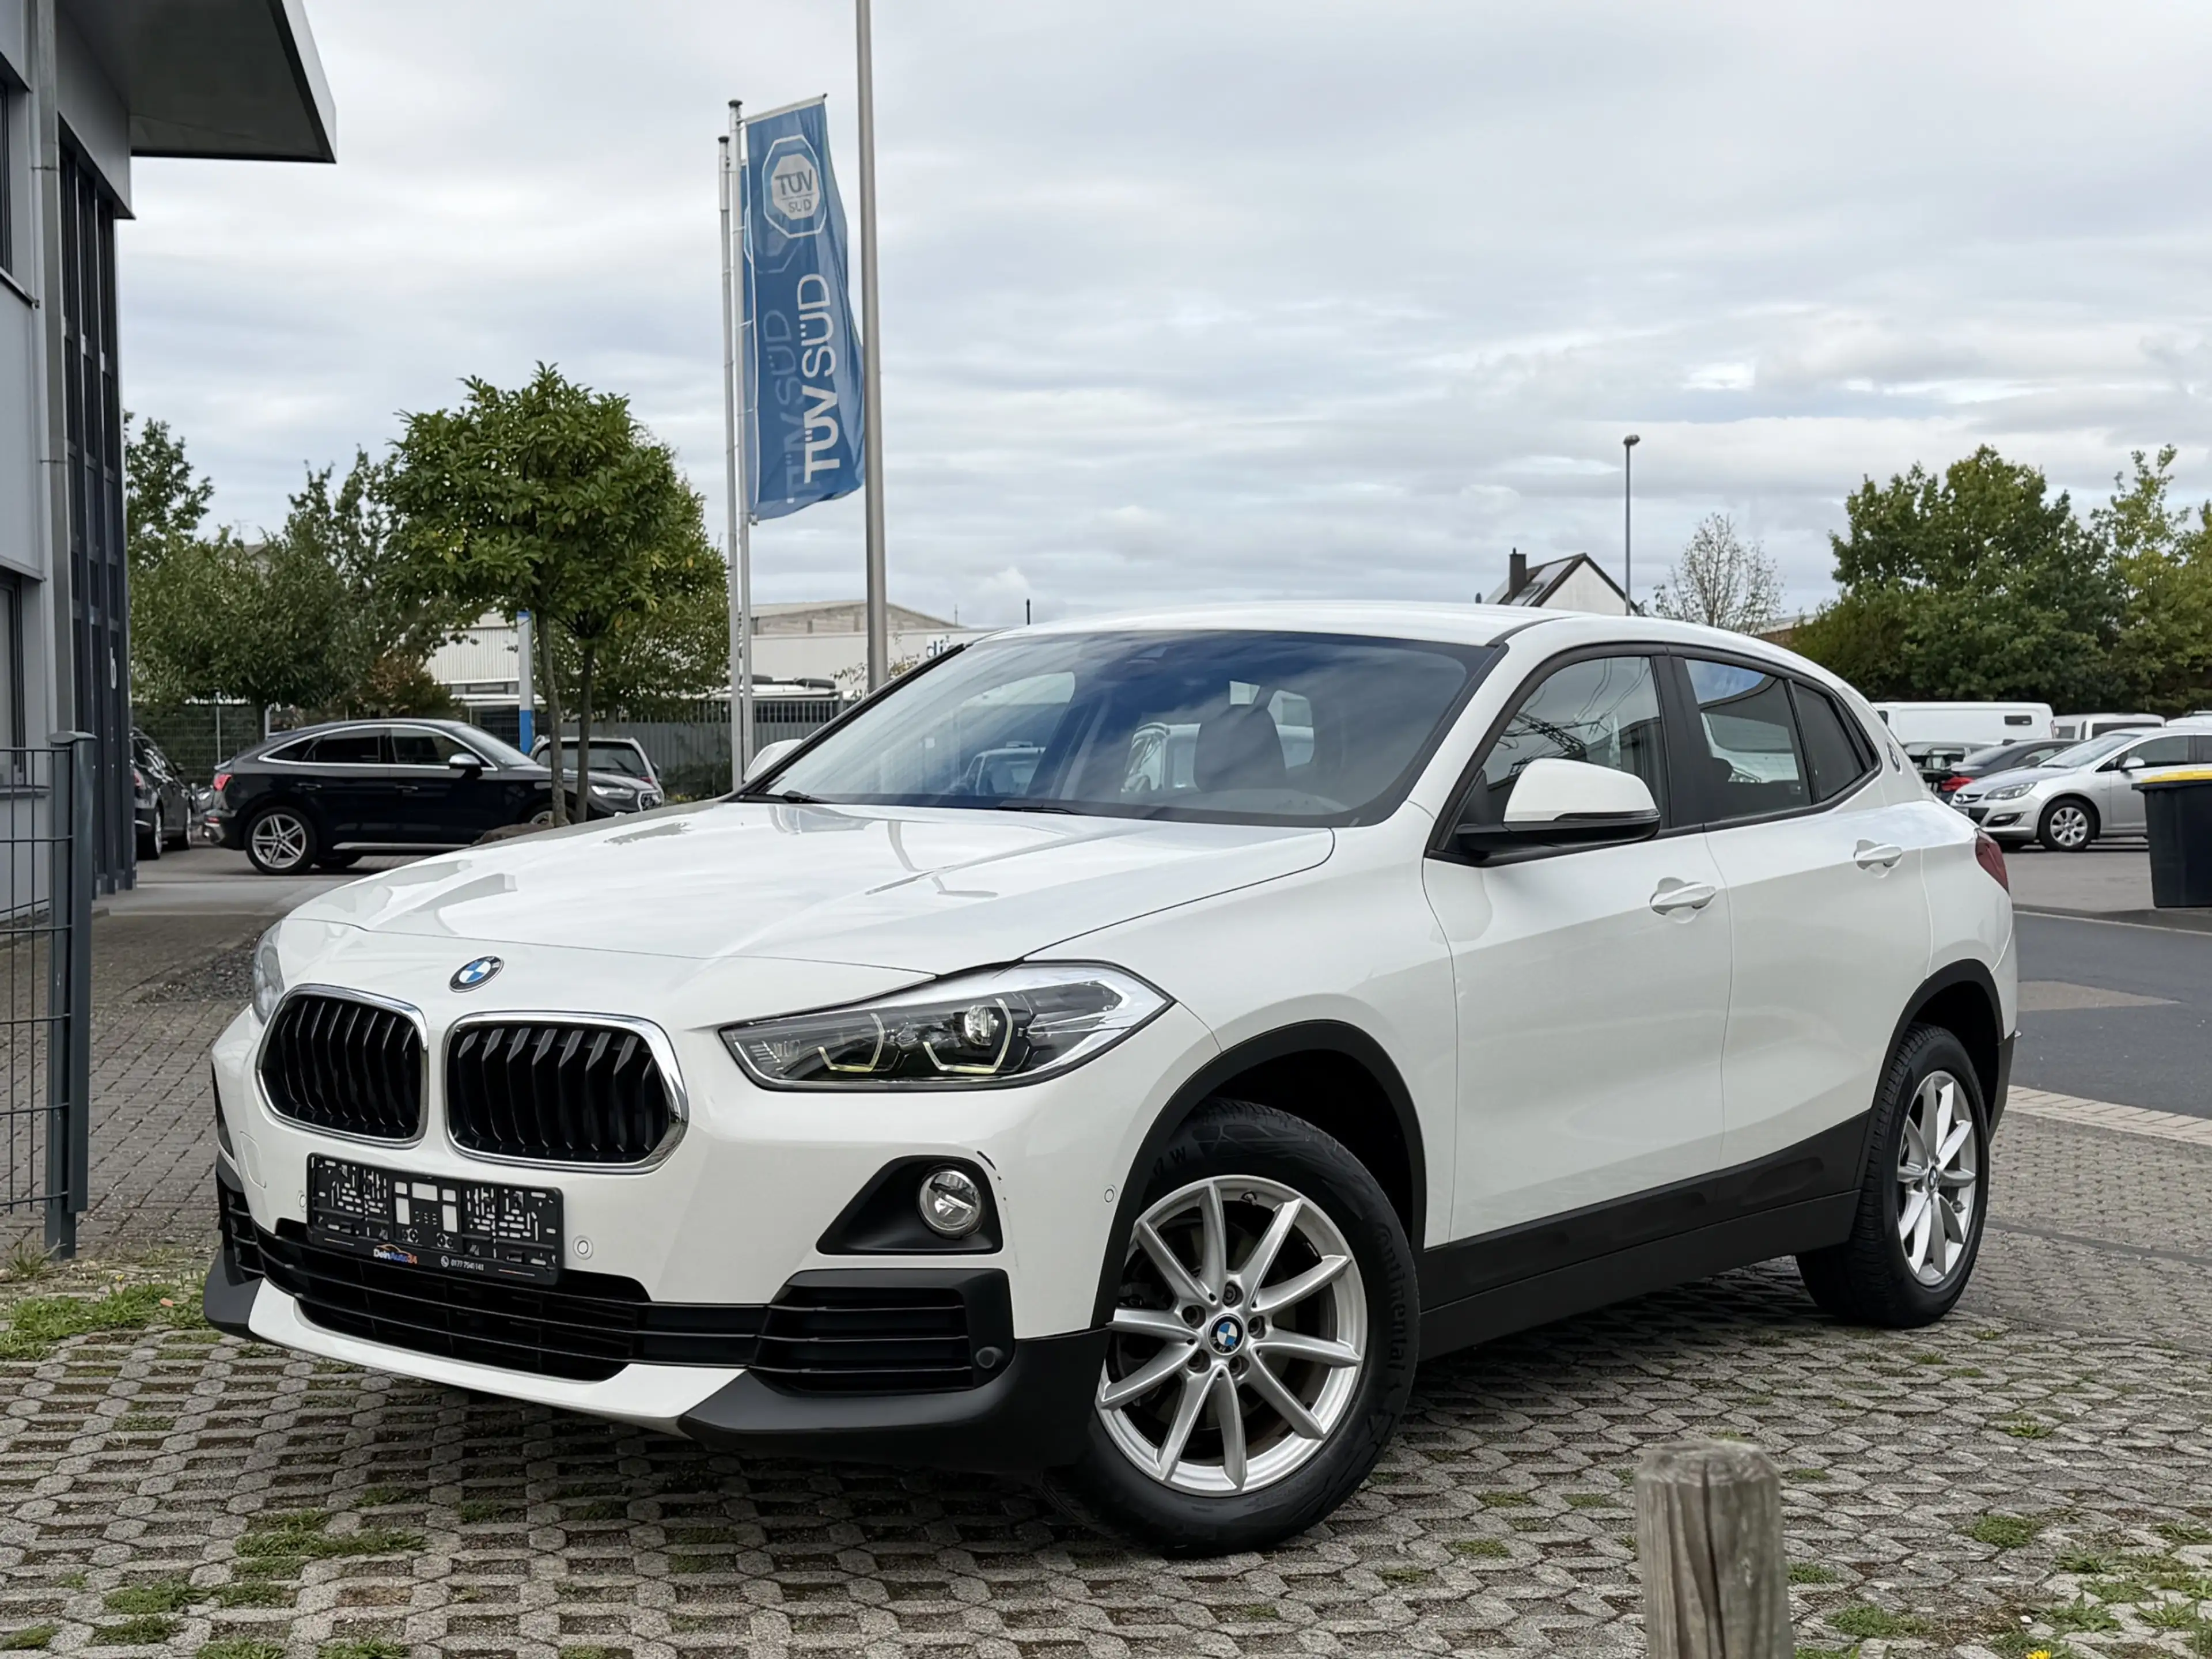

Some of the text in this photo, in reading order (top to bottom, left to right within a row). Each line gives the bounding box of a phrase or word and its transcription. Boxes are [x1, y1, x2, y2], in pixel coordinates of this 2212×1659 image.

[797, 273, 840, 484] TÜV SÜD
[926, 639, 956, 658] di
[1373, 1222, 1408, 1371] Continental
